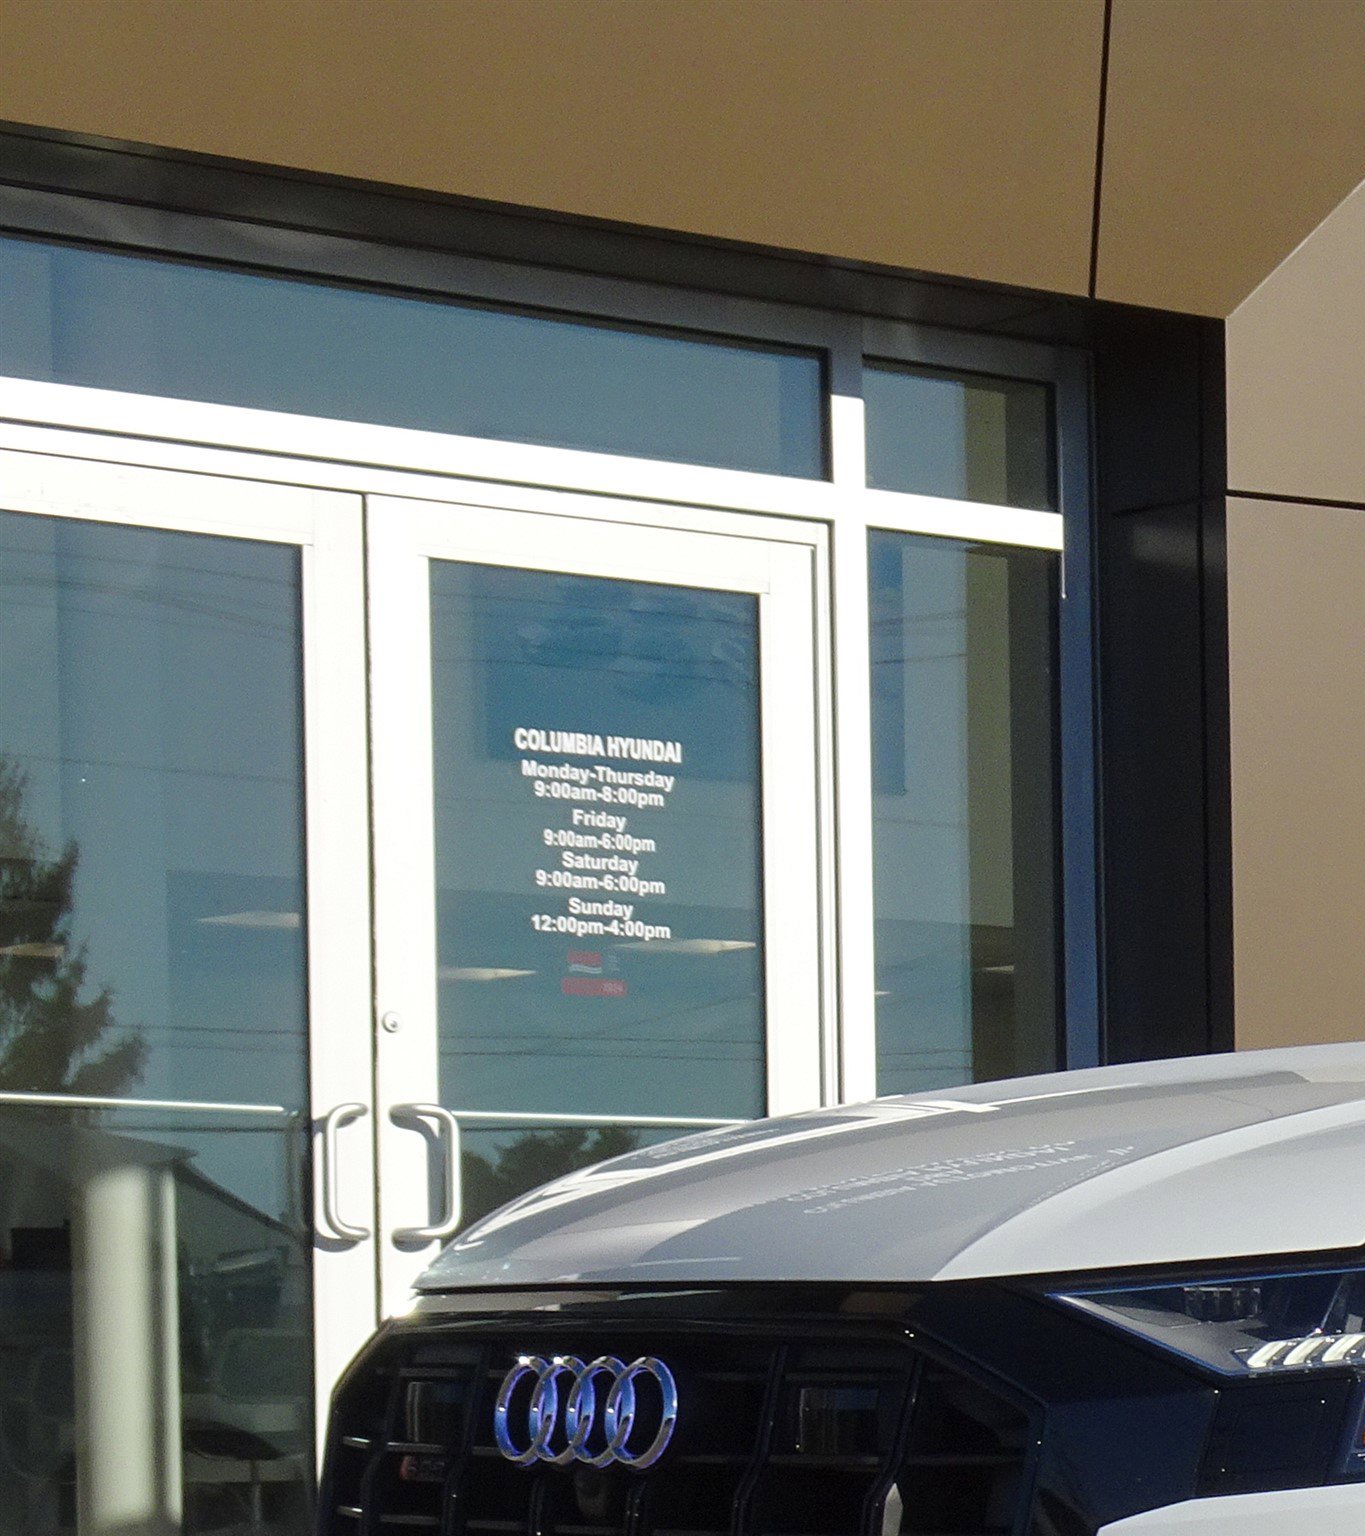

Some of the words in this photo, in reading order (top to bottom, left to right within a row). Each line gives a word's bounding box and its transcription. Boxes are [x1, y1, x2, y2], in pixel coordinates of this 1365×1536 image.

[514, 727, 605, 757] COLUMBIA
[607, 735, 682, 763] HYUNDAI
[521, 760, 675, 791] Monday-Thursday
[534, 780, 665, 808] 9:00am-8:00pm
[572, 809, 627, 832] Friday
[543, 829, 656, 853] 9:00am-6:00pm
[562, 852, 639, 876] Saturday
[535, 869, 666, 896] 9:00am-6:00pm
[568, 897, 634, 920] Sunday
[531, 914, 671, 941] 12:00pm-4:00pm
